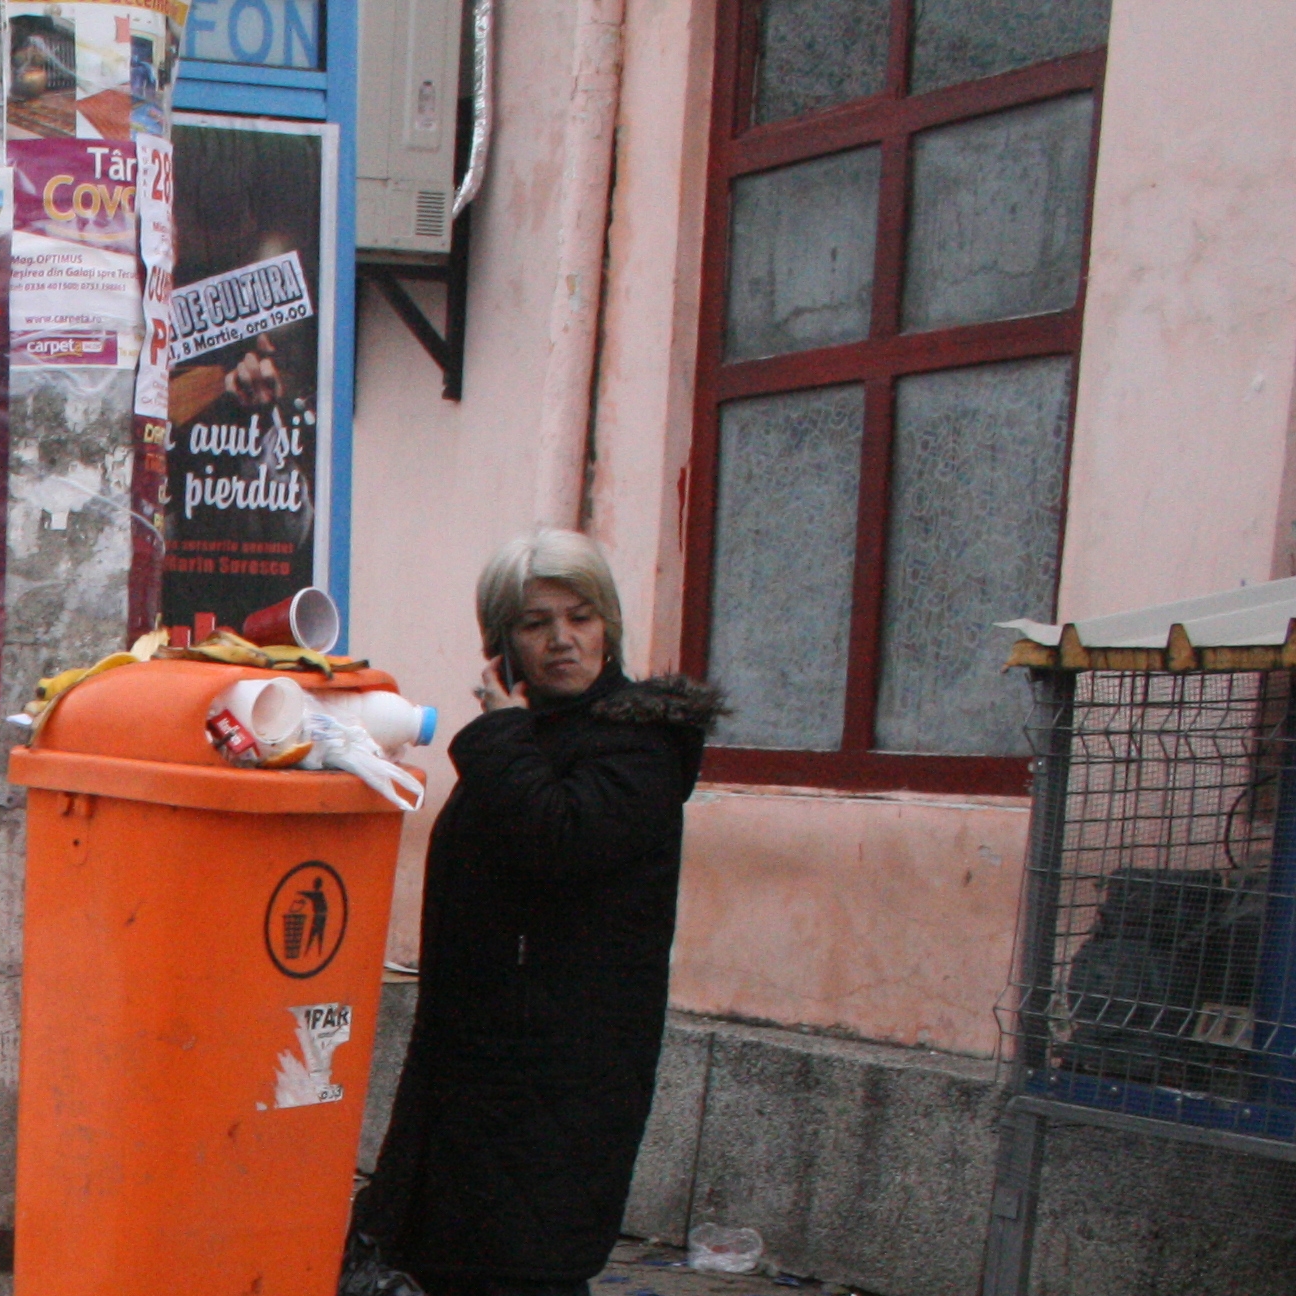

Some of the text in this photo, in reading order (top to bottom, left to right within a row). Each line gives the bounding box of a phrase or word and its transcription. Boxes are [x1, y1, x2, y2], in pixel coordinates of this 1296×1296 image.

[87, 147, 137, 181] Târ
[172, 291, 208, 338] DE
[204, 259, 304, 327] CULTURA
[269, 303, 307, 327] 19.00
[190, 414, 262, 457] avut
[185, 463, 302, 520] pierdut
